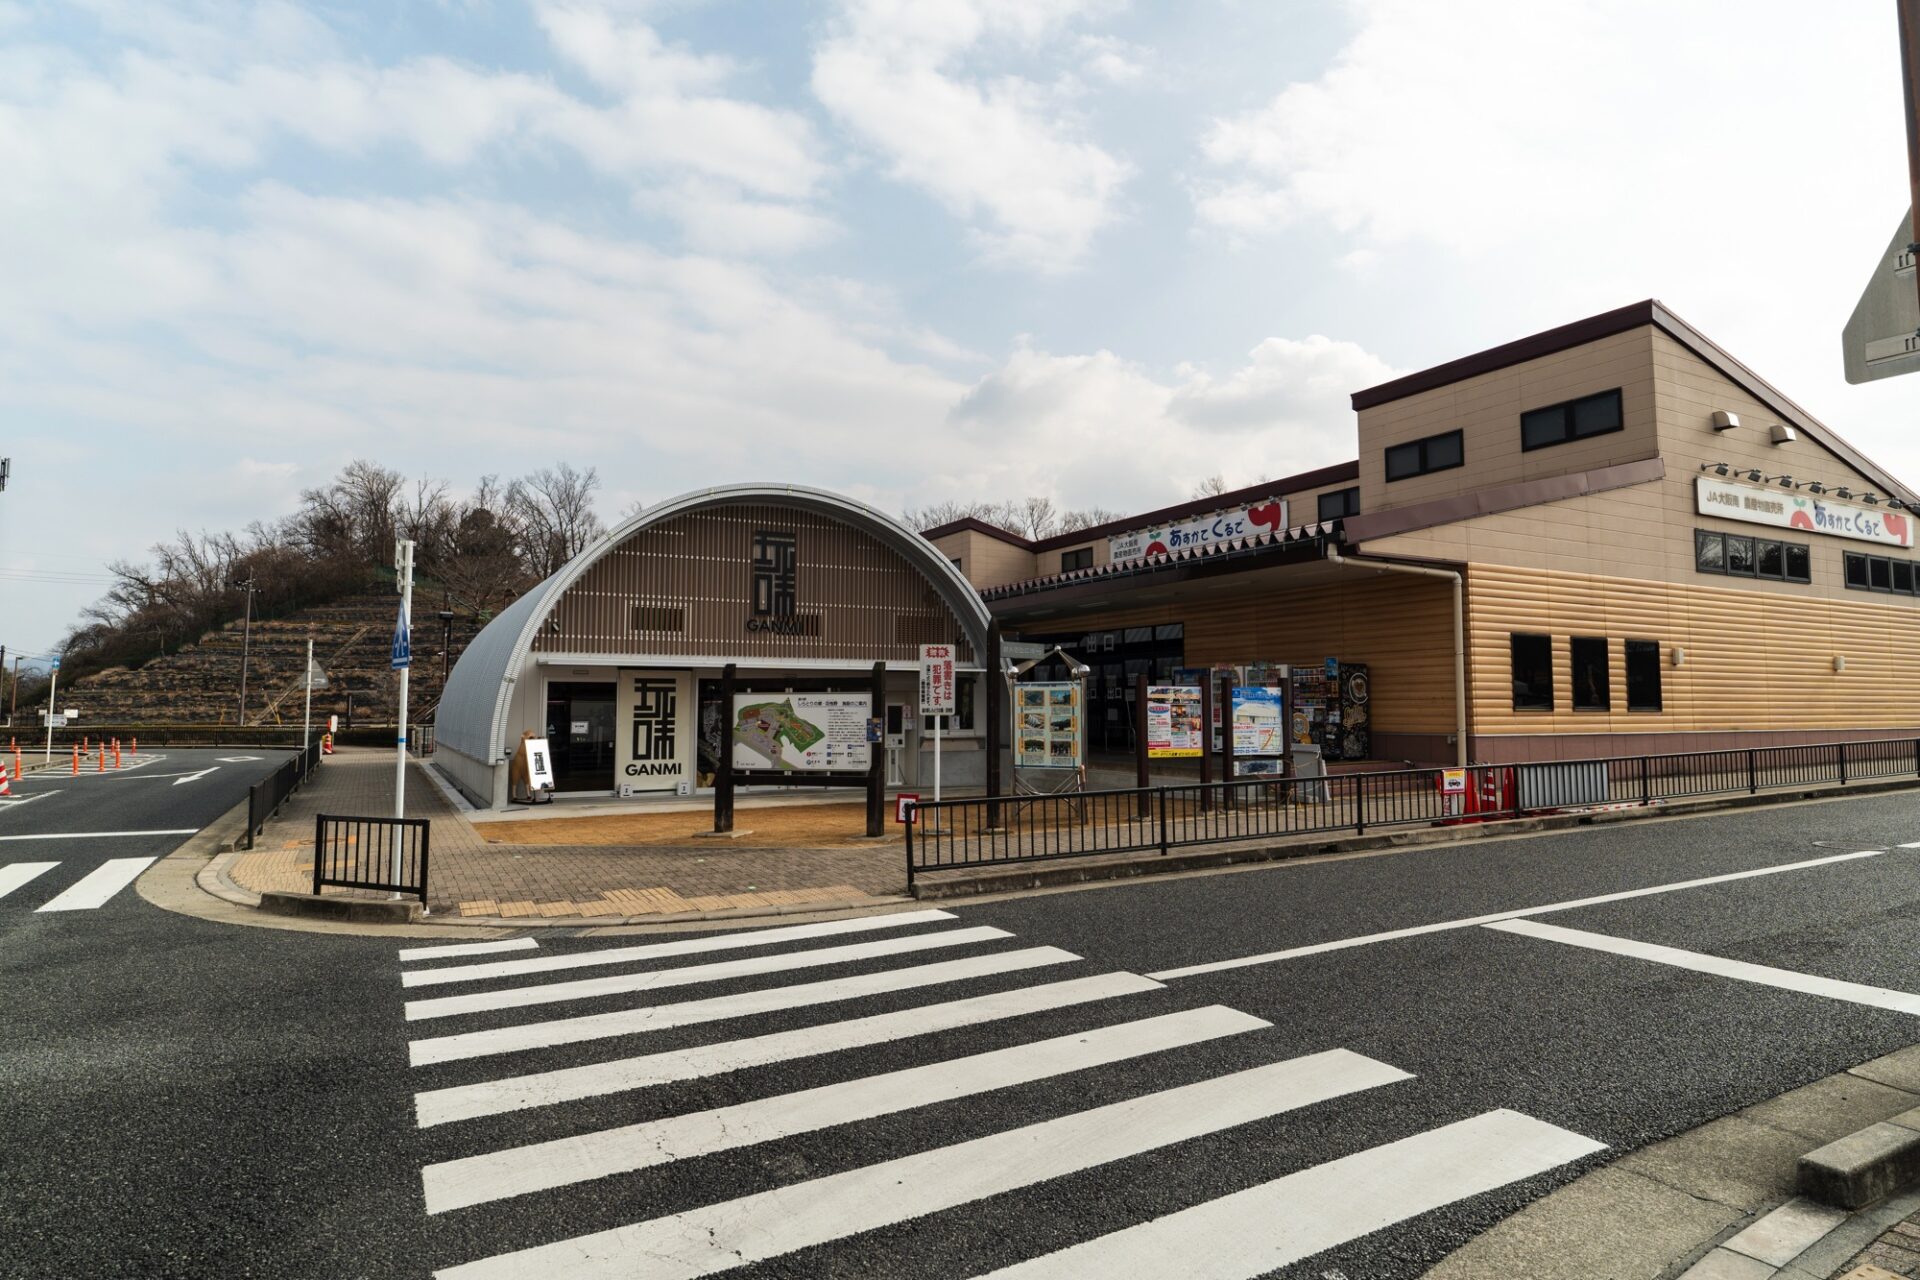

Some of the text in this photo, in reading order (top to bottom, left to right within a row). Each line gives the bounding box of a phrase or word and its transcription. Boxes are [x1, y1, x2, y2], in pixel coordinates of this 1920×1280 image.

[746, 618, 803, 635] GANMI
[1086, 634, 1114, 653] 出口
[943, 660, 952, 701] 落書きは
[625, 763, 682, 776] GANMI
